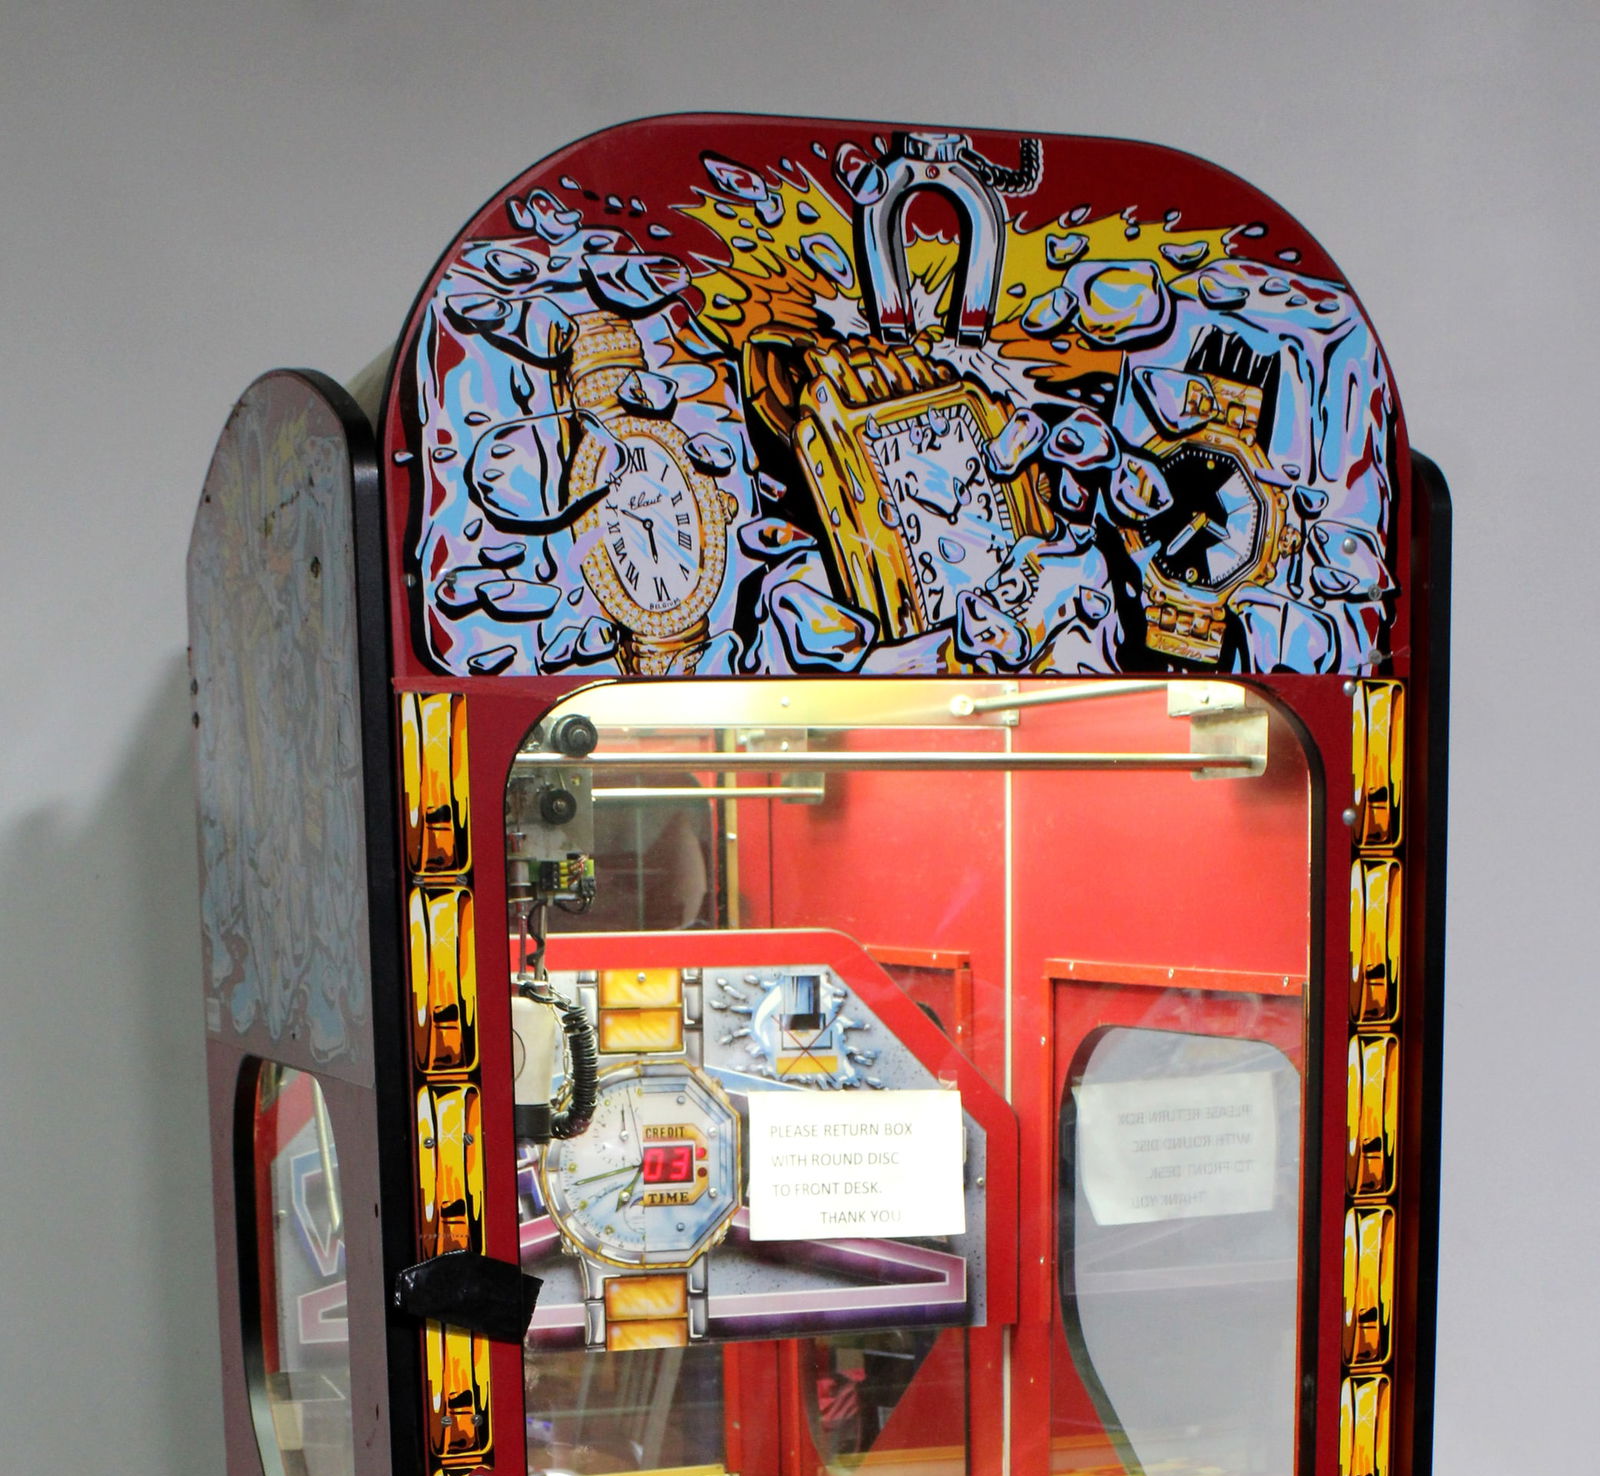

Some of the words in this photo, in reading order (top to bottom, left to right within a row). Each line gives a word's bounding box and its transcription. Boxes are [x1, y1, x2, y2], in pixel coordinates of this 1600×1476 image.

[954, 420, 964, 443] 1
[628, 447, 648, 474] XII
[880, 437, 900, 467] 11
[965, 456, 985, 489] 2
[977, 492, 994, 523] 3
[906, 513, 922, 545] 9
[918, 551, 937, 584] 8
[928, 585, 945, 621] 7
[645, 1126, 686, 1139] CREDIT
[770, 1124, 818, 1138] PLEASE
[824, 1123, 879, 1137] RETURN
[884, 1122, 913, 1136] BOX
[643, 1147, 690, 1182] 03
[771, 1154, 807, 1168] WITH
[812, 1153, 863, 1167] ROUND
[868, 1152, 900, 1166] DISC
[648, 1191, 690, 1205] TIME
[772, 1184, 791, 1198] TO
[795, 1182, 839, 1196] FRONT
[820, 1210, 866, 1225] THANK
[870, 1209, 901, 1223] YOU
